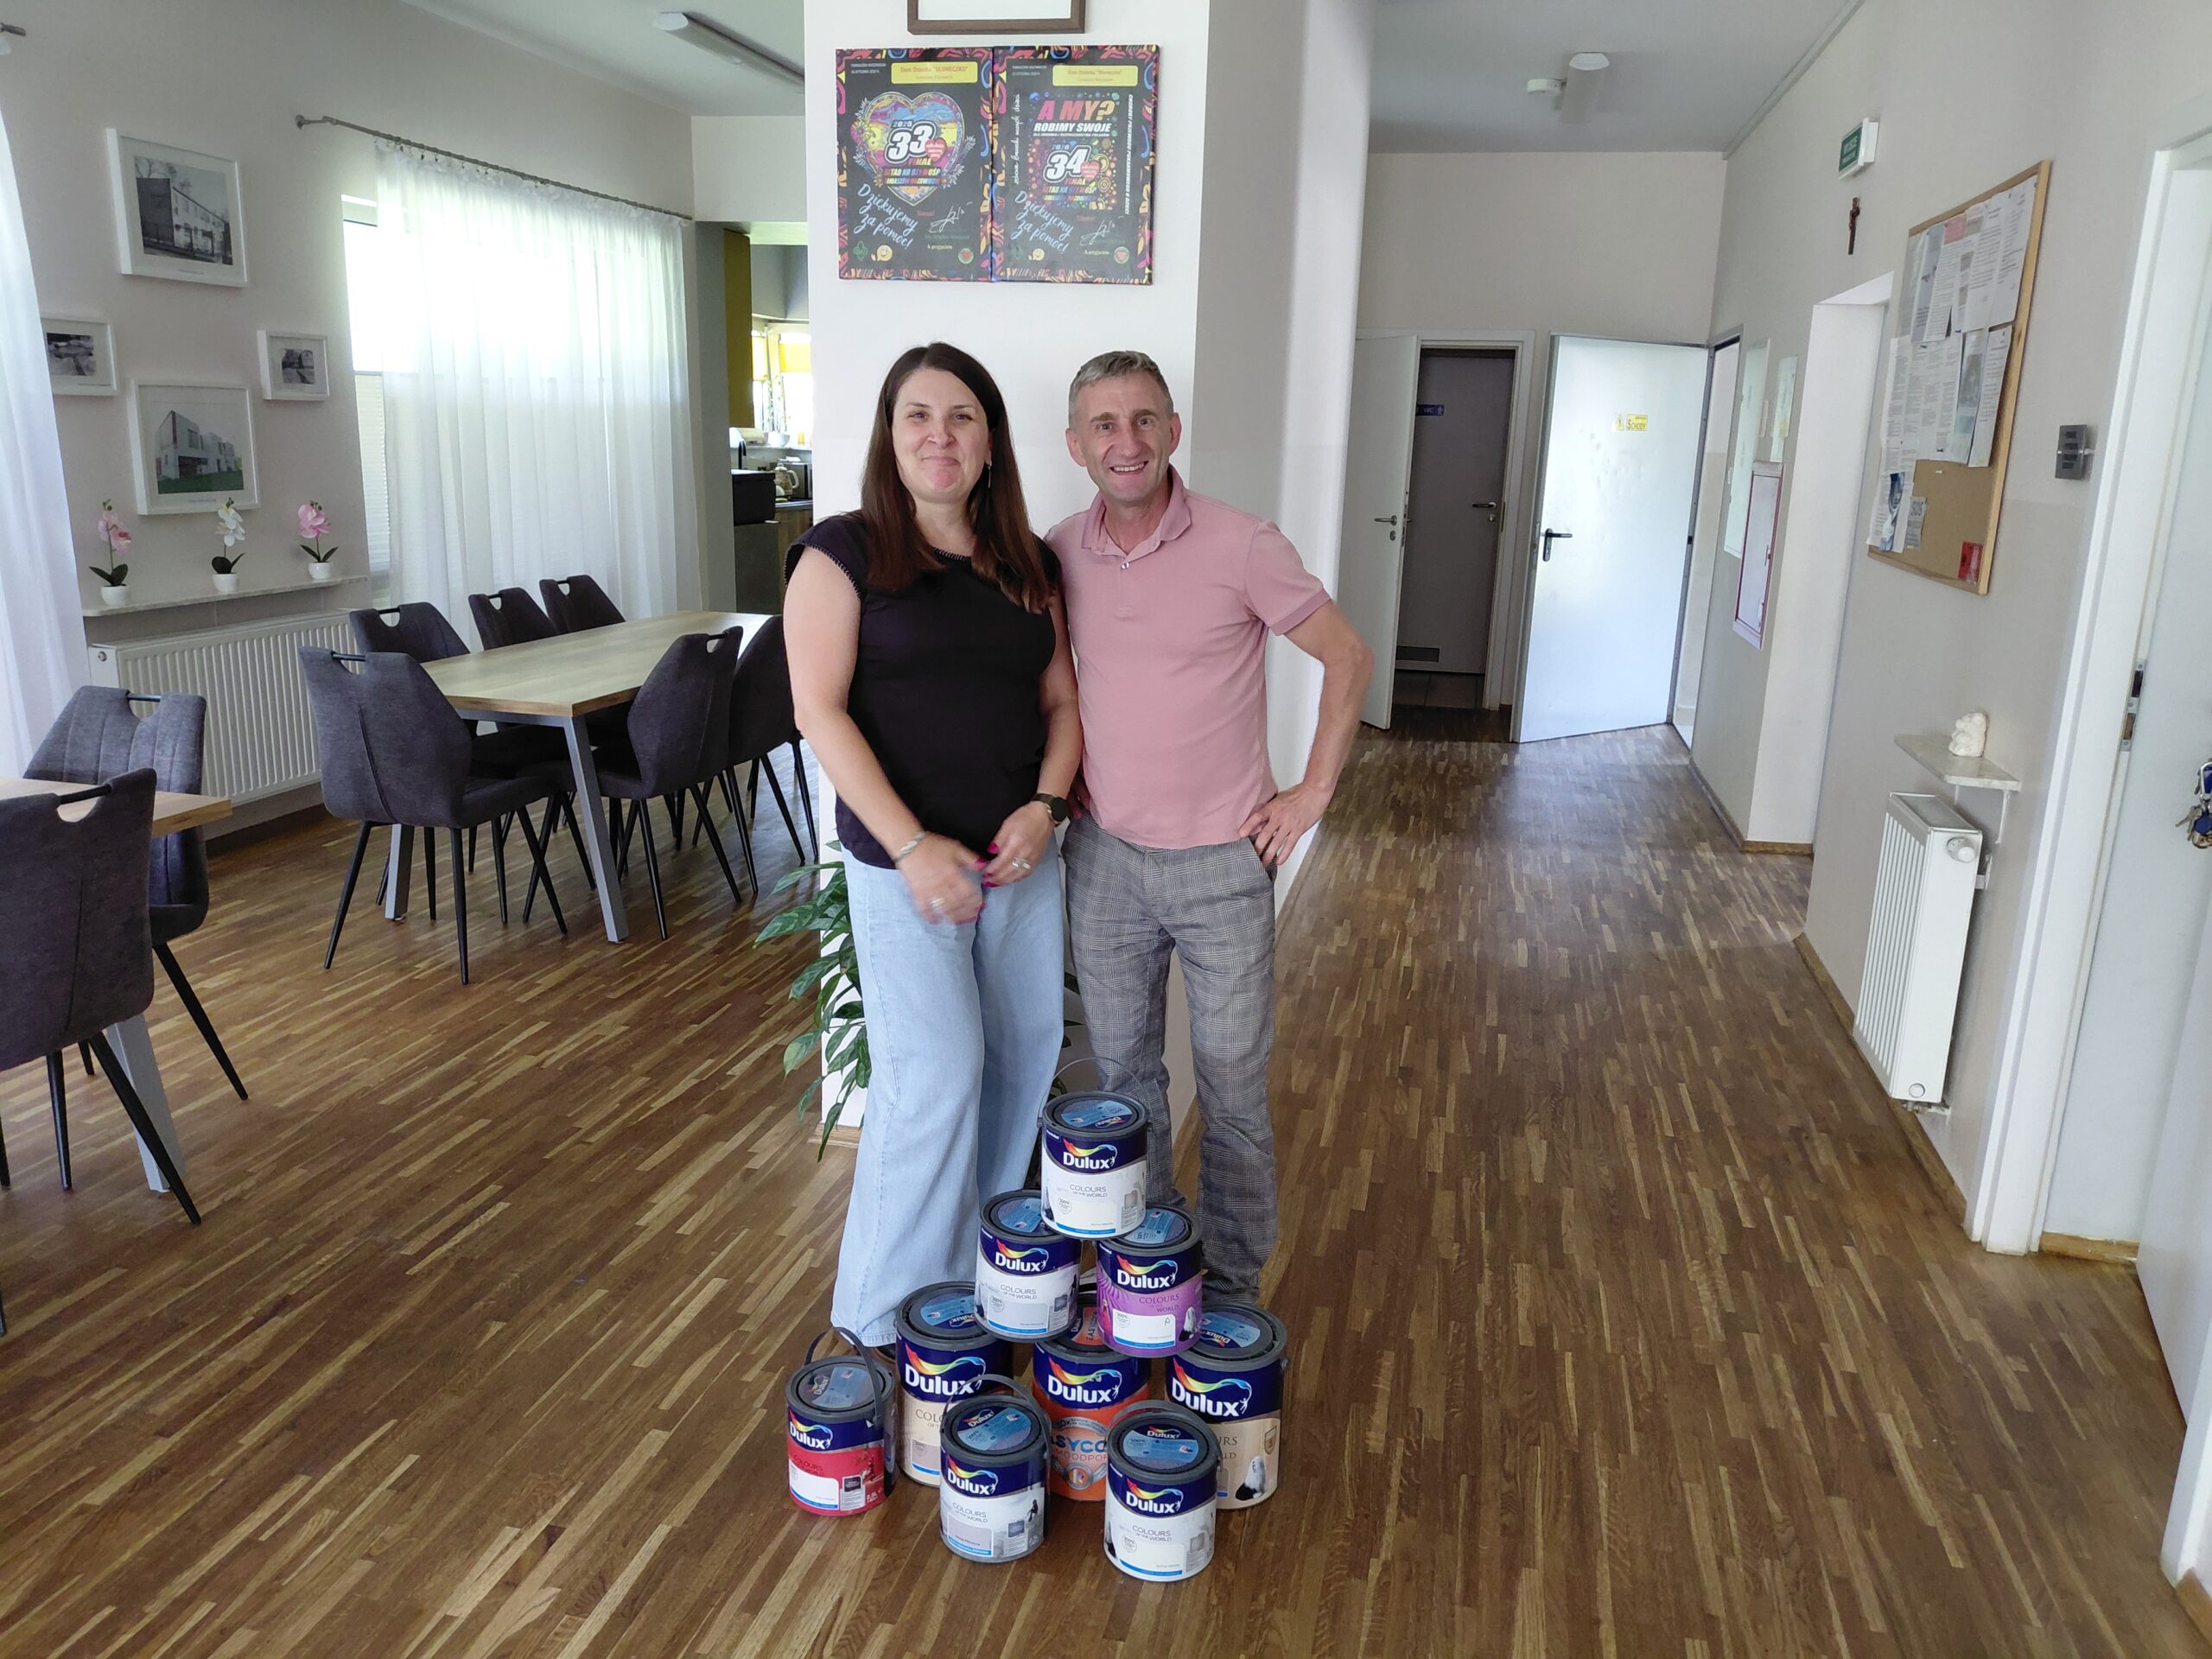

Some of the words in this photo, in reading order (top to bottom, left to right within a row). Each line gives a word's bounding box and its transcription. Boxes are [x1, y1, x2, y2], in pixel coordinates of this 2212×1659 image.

[1037, 100, 1056, 121] A
[1058, 100, 1116, 121] MY?
[1033, 123, 1076, 132] ROBIMY
[1076, 123, 1113, 132] SWOJE
[886, 122, 935, 163] 33
[1045, 147, 1090, 181] 34
[857, 184, 918, 236] Dziękujemy
[1014, 191, 1074, 240] Dziękujemy
[853, 212, 876, 235] za
[873, 221, 913, 250] pomoc!
[1010, 219, 1033, 240] za
[1029, 227, 1070, 255] pomoc!
[1095, 1116, 1122, 1127] Dulux
[1063, 1151, 1110, 1170] Dulux
[1070, 1184, 1107, 1193] COLOURS
[995, 1251, 1041, 1272] Dulux
[1117, 1268, 1171, 1289] Dulux
[1000, 1284, 1037, 1295] COLOURS
[1139, 1293, 1179, 1305] COLOURS
[1156, 1305, 1179, 1313] WORLD
[1205, 1331, 1231, 1344] Dulux
[905, 1363, 975, 1396] Dulux
[1048, 1375, 1112, 1404] Dulux
[1172, 1377, 1240, 1417] Dulux
[968, 1412, 994, 1427] Dulux
[790, 1421, 827, 1450] Dulux
[1147, 1430, 1176, 1440] Dulux
[947, 1468, 991, 1496] Dulux
[952, 1502, 987, 1518] COLOURS
[1126, 1491, 1176, 1513] Dulux
[1132, 1525, 1172, 1537] COLOURS
